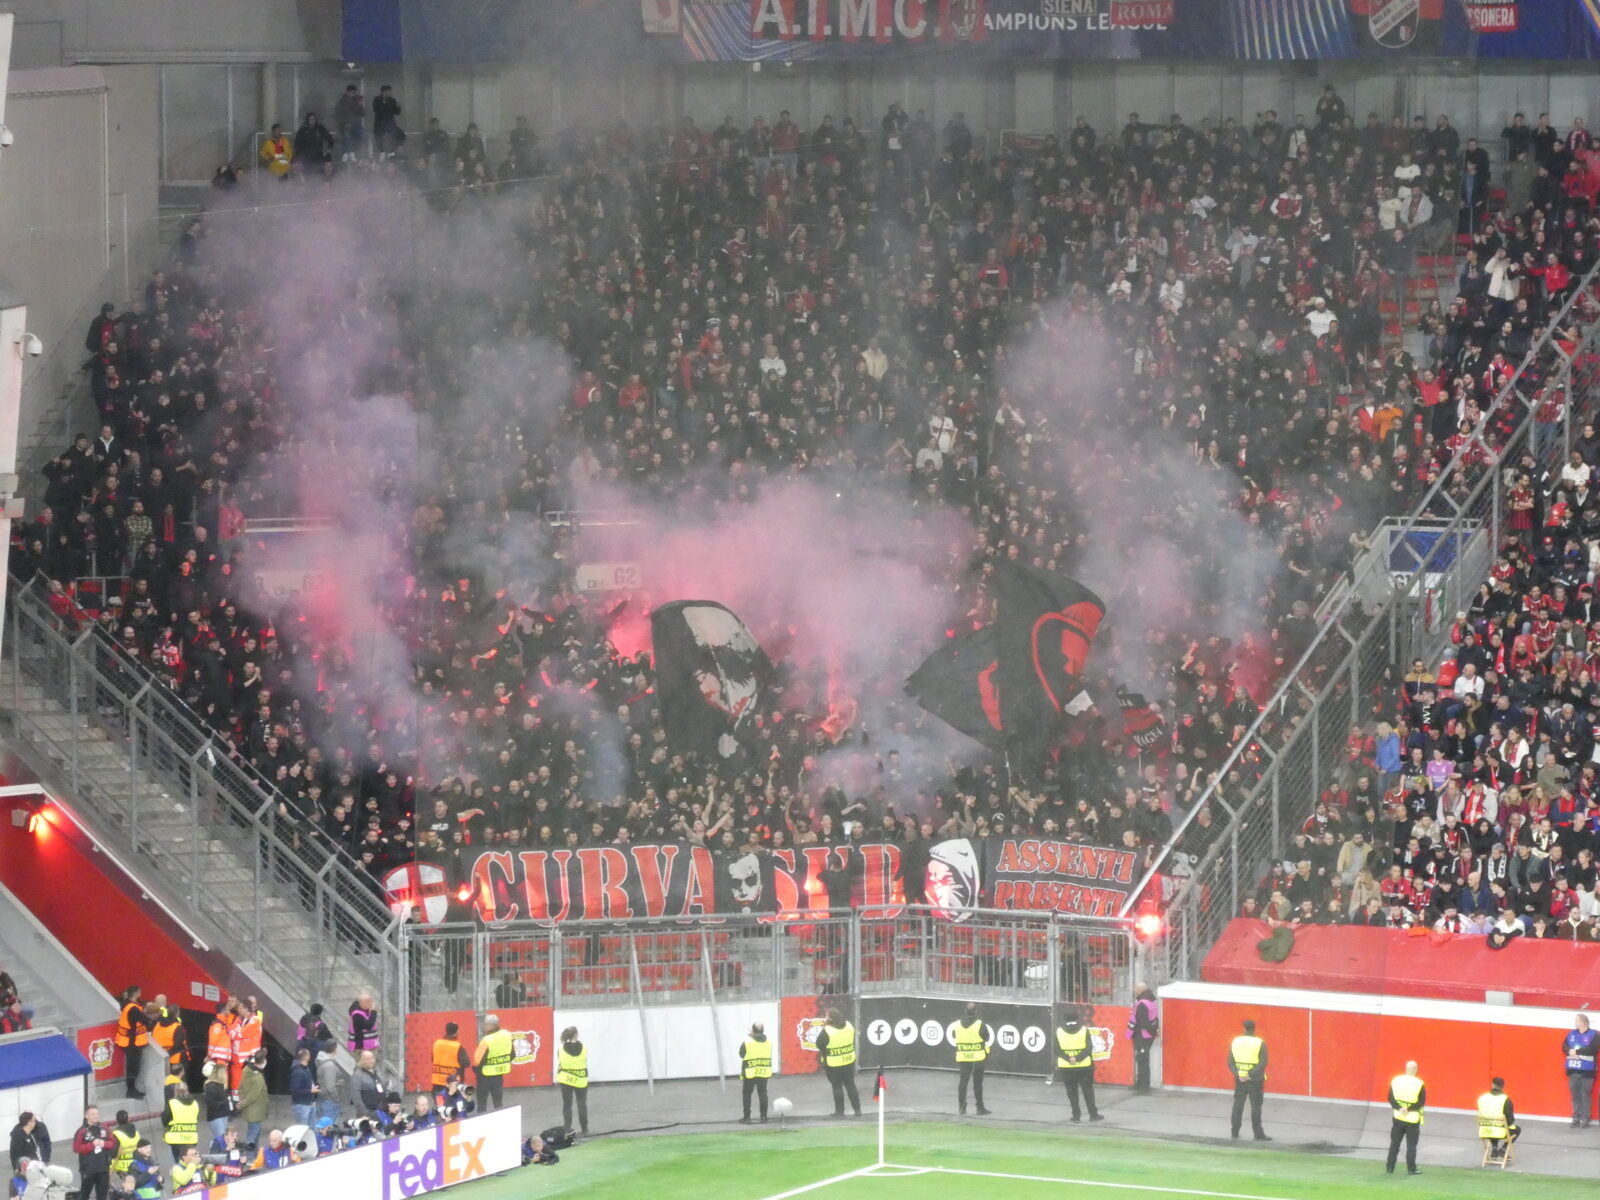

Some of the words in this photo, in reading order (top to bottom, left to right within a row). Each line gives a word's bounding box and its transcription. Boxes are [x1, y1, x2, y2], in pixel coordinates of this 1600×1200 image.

[983, 12, 1078, 30] AMPIONS
[996, 839, 1136, 884] ASSENTI
[471, 845, 725, 928] CURVA
[994, 880, 1127, 918] PRESENTI
[382, 1121, 486, 1200] FedEx
